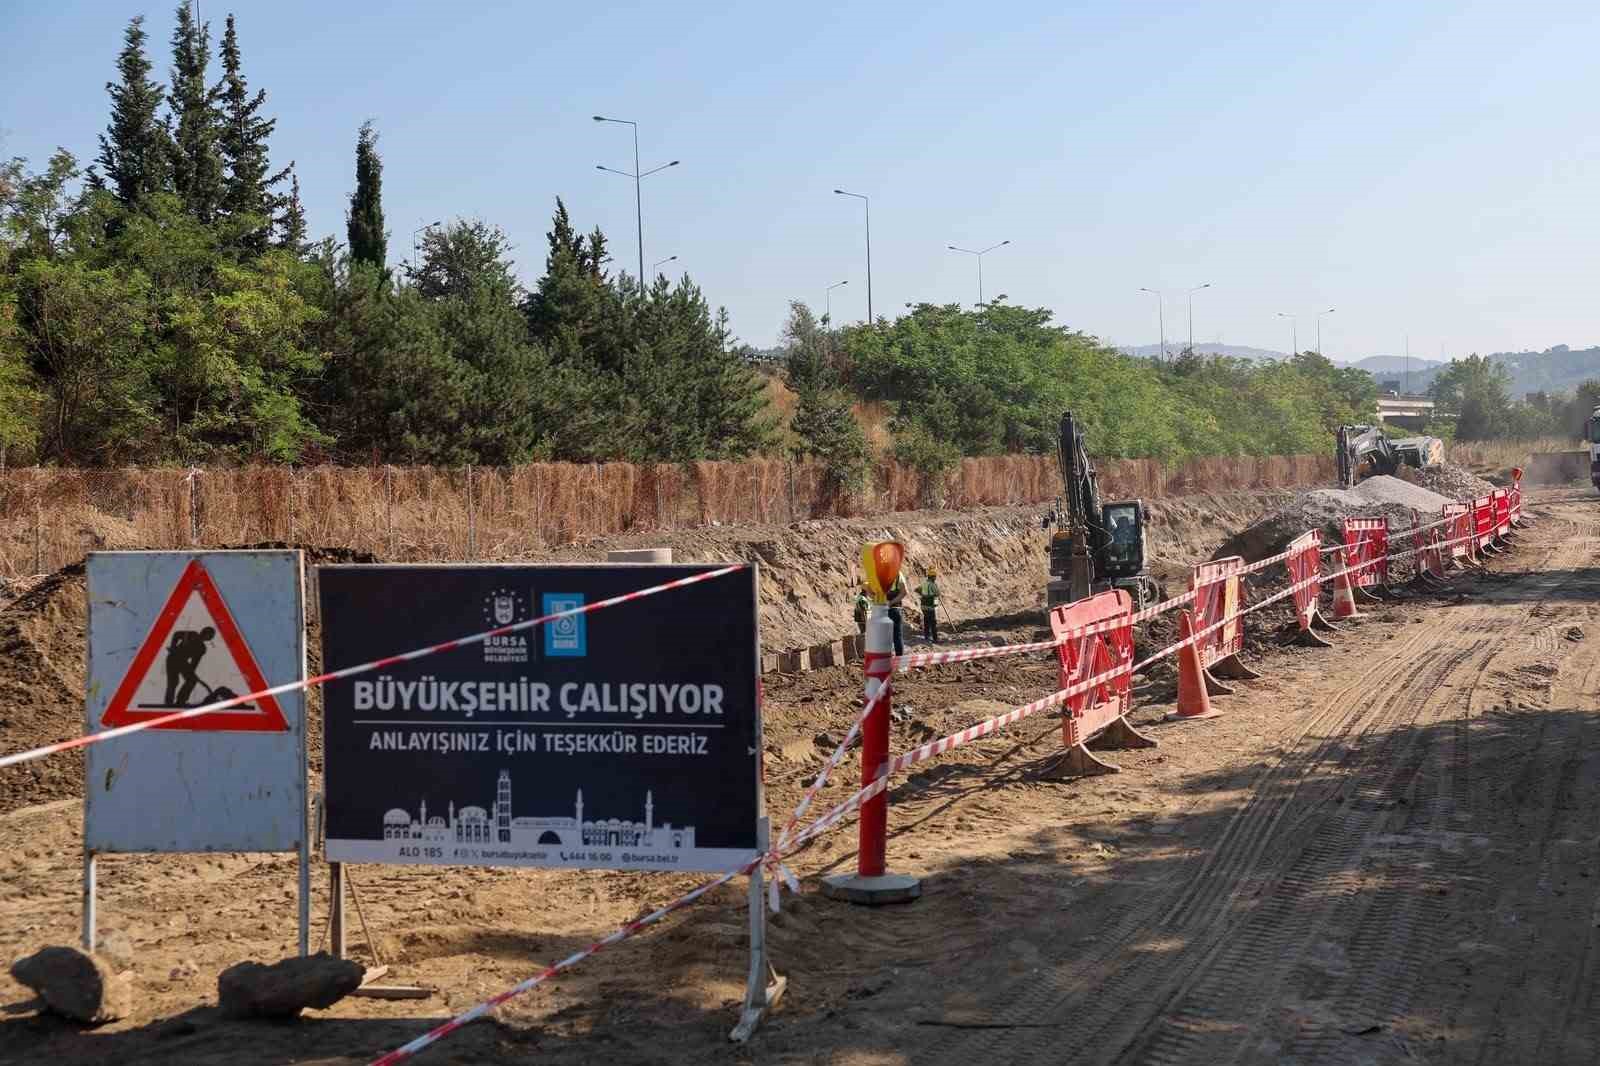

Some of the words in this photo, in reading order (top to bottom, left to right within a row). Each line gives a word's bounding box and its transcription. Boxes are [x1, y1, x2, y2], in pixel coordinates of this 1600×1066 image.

[353, 675, 551, 717] BÜYÜKŞEHİR
[559, 683, 724, 719] ÇALIŞIYOR
[369, 731, 489, 755] ANLAYIŞINIZ
[496, 729, 537, 755] İÇİN
[543, 731, 637, 756] TEŞEKKÜR
[643, 732, 708, 755] EDERİZ
[398, 847, 421, 858] ALO
[423, 848, 443, 858] 185
[569, 852, 585, 861] 444
